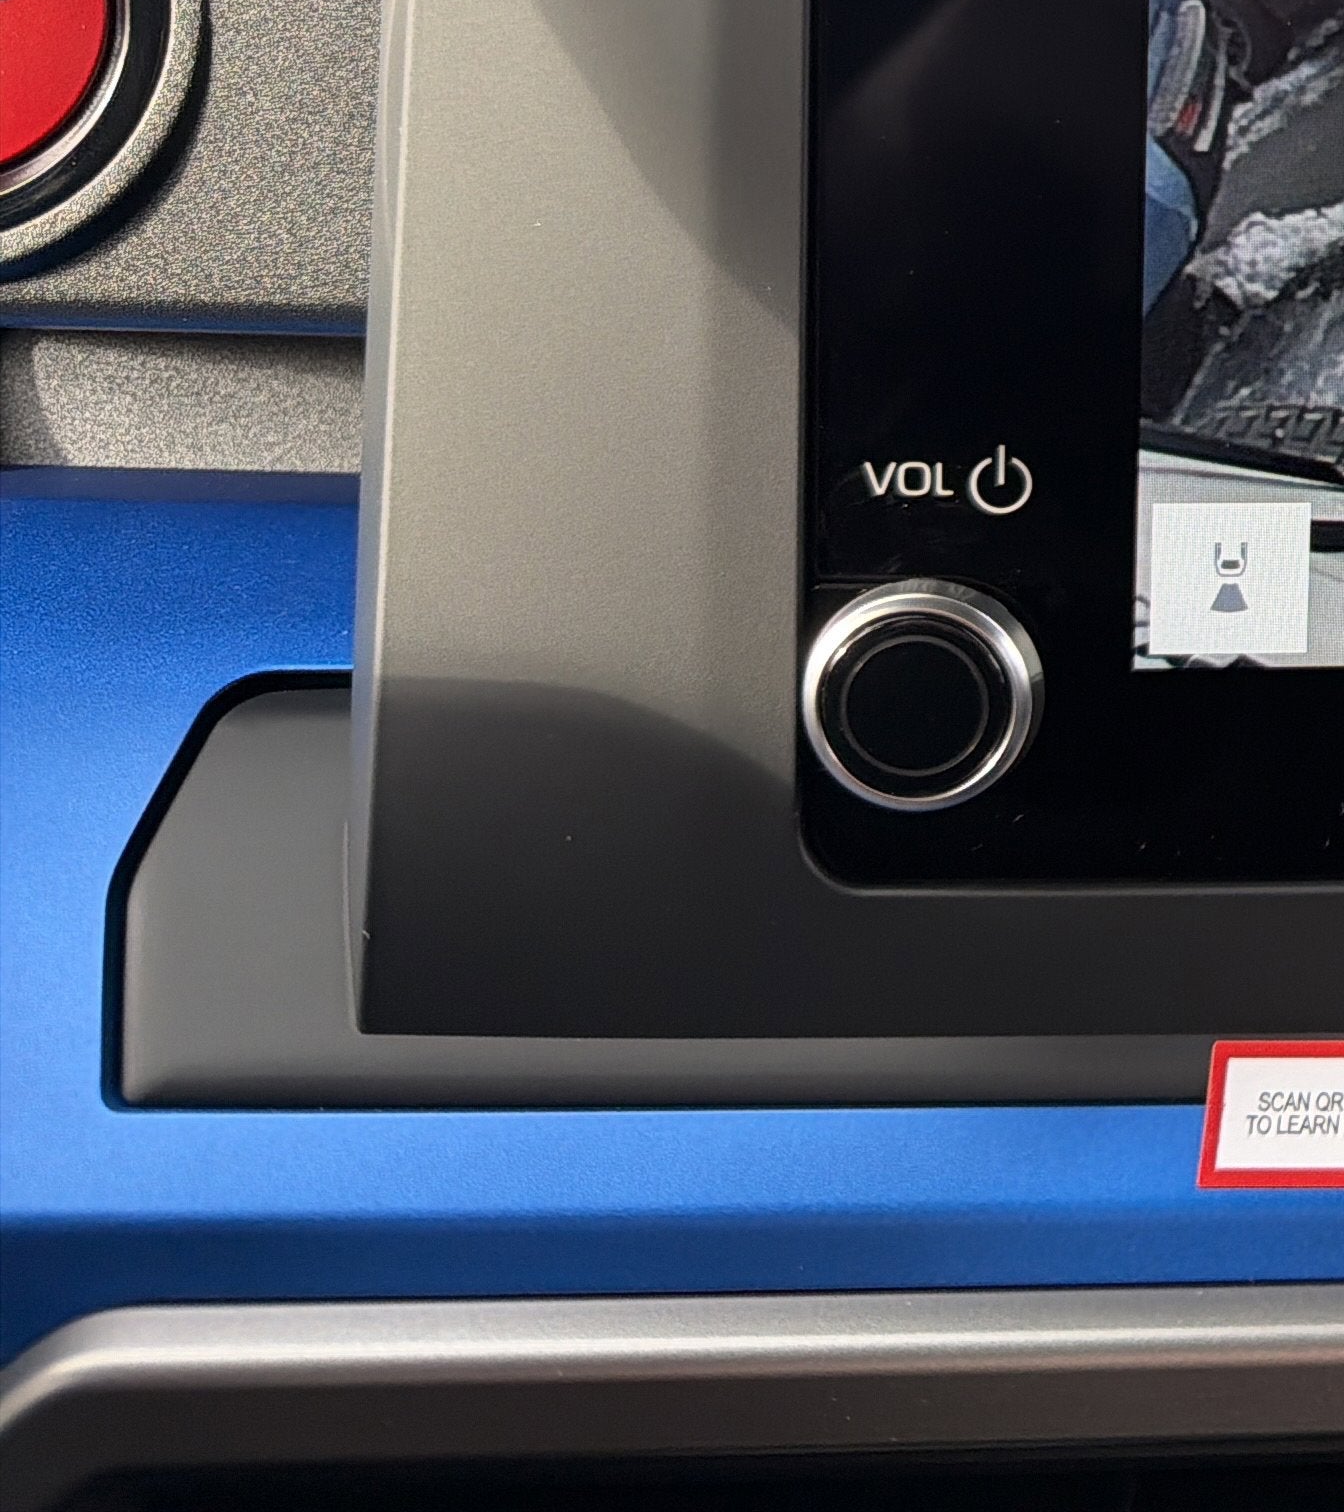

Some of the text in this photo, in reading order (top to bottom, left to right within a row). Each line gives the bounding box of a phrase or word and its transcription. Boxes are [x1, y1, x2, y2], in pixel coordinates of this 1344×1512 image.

[862, 461, 954, 497] VOL
[1258, 1091, 1311, 1112] SCAN
[1315, 1091, 1344, 1112] QR
[1247, 1114, 1272, 1136] TO
[1276, 1114, 1341, 1136] LEARN
